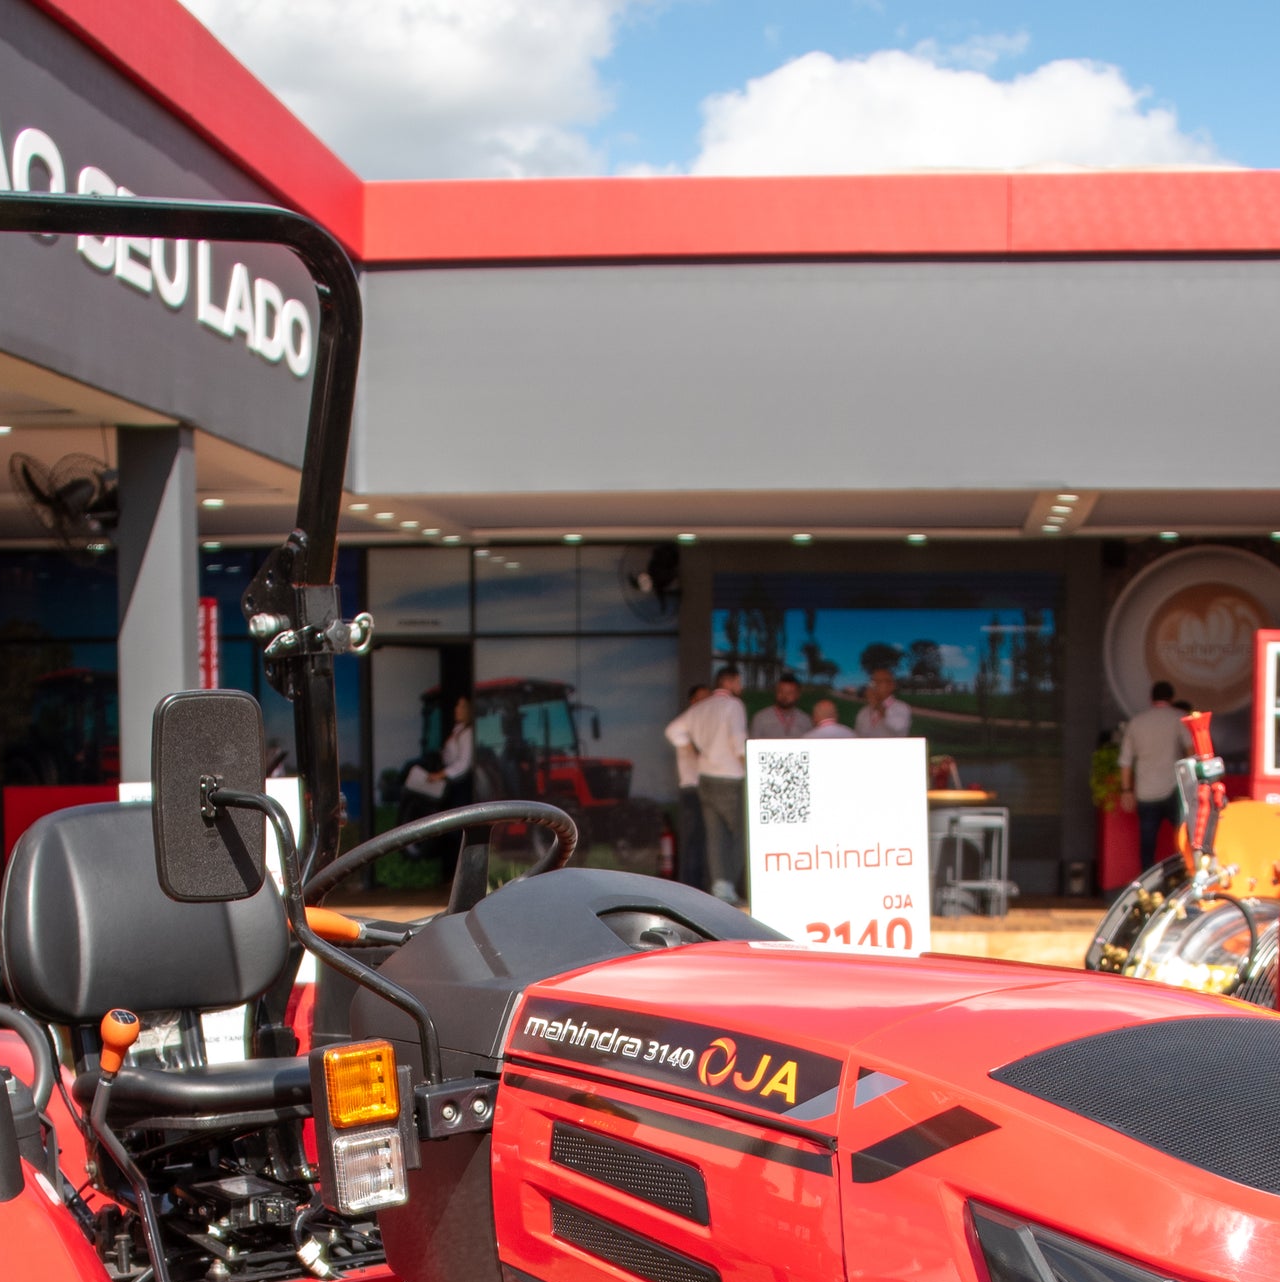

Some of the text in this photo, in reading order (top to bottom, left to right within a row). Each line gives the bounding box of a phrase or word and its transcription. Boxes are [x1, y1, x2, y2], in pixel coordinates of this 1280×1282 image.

[196, 238, 312, 377] LADO
[765, 842, 913, 872] mahindra
[883, 895, 913, 910] OJA
[806, 917, 913, 950] 3140
[523, 1016, 799, 1104] mahindra 3140 OJA
